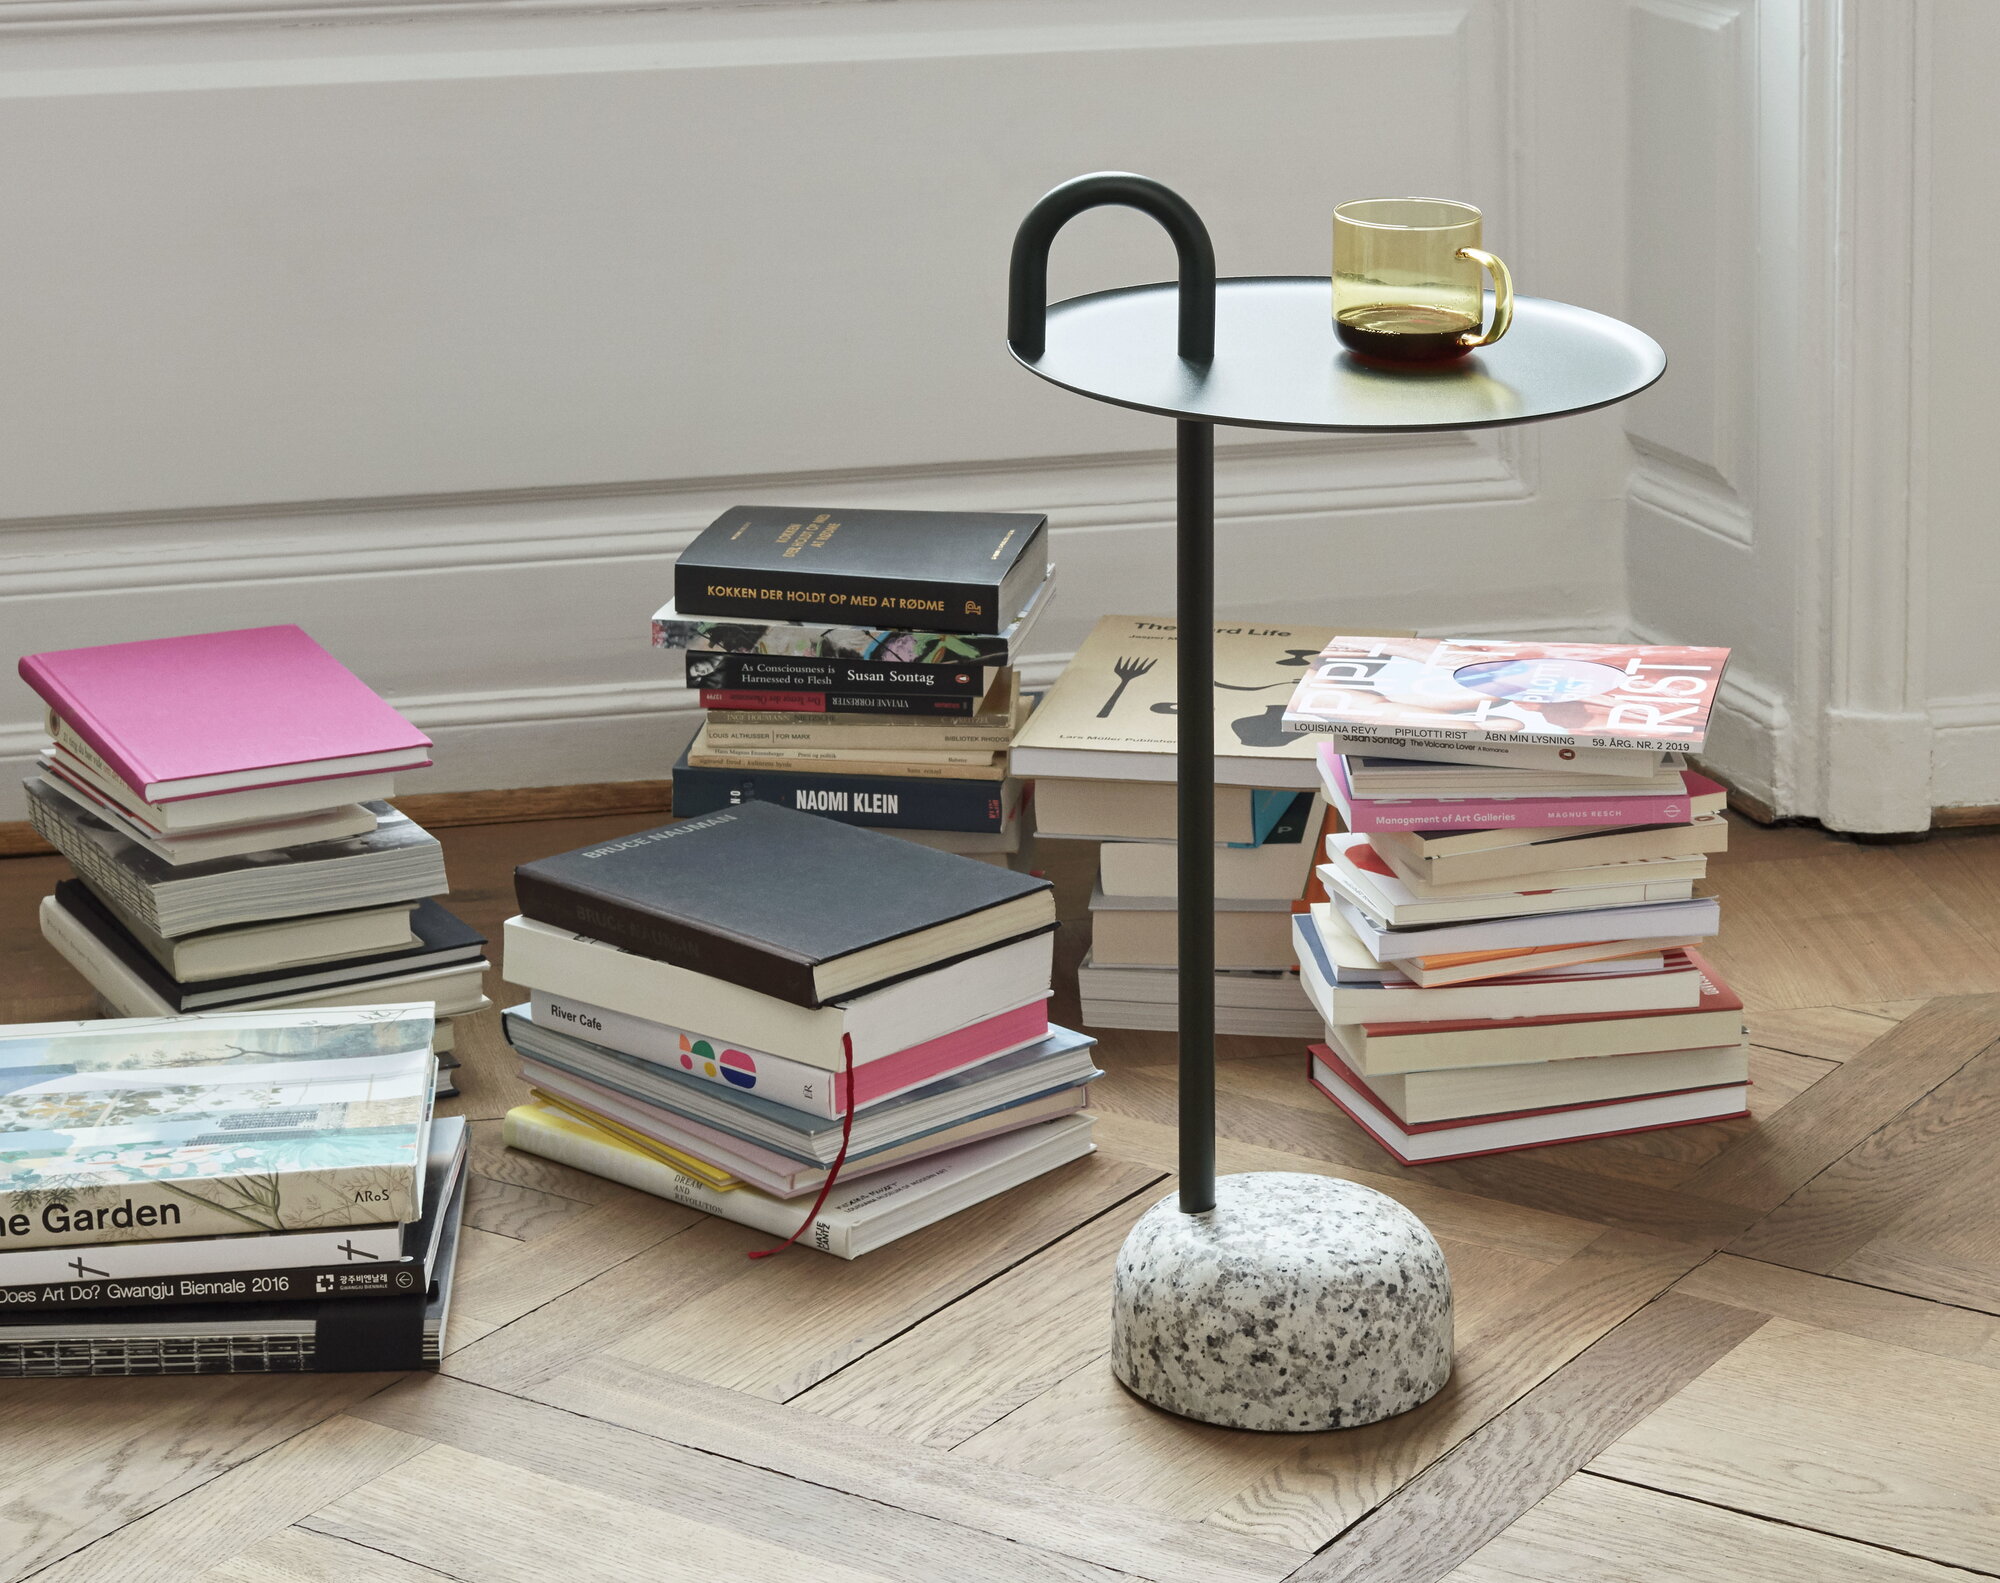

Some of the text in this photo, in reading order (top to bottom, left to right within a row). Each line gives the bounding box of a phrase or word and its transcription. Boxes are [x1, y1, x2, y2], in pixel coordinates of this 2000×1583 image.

[707, 585, 945, 611] KOKKEN DER HOLDT OP MED AT RØDME
[1134, 622, 1177, 631] The
[1247, 629, 1292, 637] Life
[742, 663, 836, 674] As Consciousness is
[742, 674, 832, 685] Harnessed to Flesh
[847, 669, 935, 686] Susan Sontag
[832, 697, 909, 708] VIVIANE FORRESTER
[1605, 658, 1712, 734] RIST
[1294, 723, 1690, 751] LOUISIANA REVY PIPILOTTI RIST ÅBN MIN LYSNING 59. ÅRG. NR. 2 2019
[1424, 740, 1454, 750] Volcano
[1456, 743, 1476, 751] Lover
[796, 789, 899, 814] NAOMI KLEIN
[1375, 814, 1440, 826] Management
[1441, 814, 1452, 823] of
[1454, 813, 1471, 823] Art
[1473, 812, 1516, 822] Galleries
[1547, 811, 1588, 819] MAGNUS
[581, 814, 738, 859] BRUCE NAUMAN
[551, 1004, 602, 1030] River Cafe
[674, 1174, 704, 1190] DREAM
[674, 1184, 690, 1195] AND
[674, 1193, 724, 1214] REVOLUTION
[42, 1199, 181, 1234] Garden
[340, 1273, 388, 1285] 광주비엔날레
[42, 1286, 65, 1302] Art
[70, 1284, 101, 1300] Do?
[107, 1281, 175, 1300] Gwangju
[180, 1278, 246, 1296] Biennale
[252, 1276, 289, 1293] 2016
